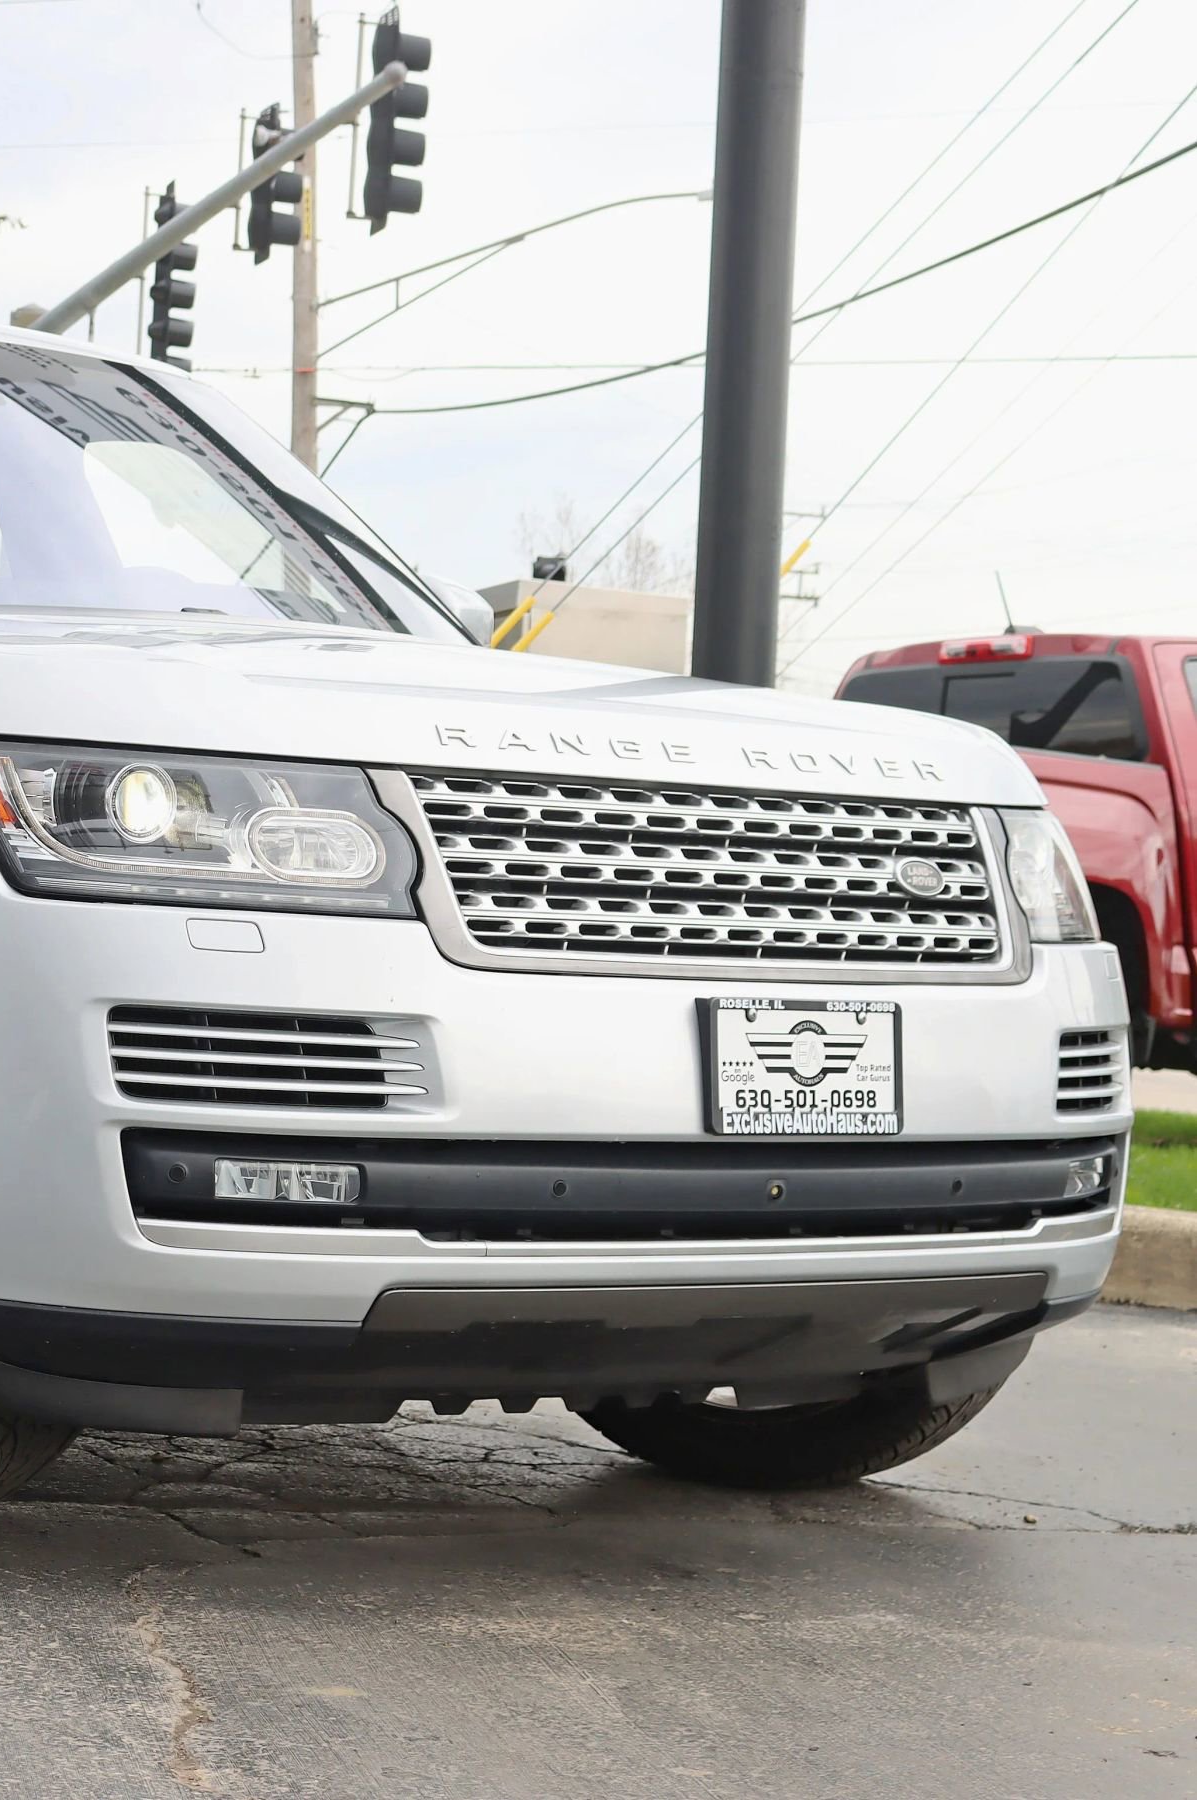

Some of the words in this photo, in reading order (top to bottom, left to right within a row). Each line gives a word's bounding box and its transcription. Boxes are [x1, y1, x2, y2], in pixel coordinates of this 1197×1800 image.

[435, 724, 697, 763] RANGE
[741, 746, 945, 782] ROVER
[719, 999, 772, 1010] ROSELLE,
[774, 999, 785, 1010] IL
[826, 1001, 896, 1013] 630-501-0698
[856, 1064, 869, 1073] Top
[870, 1064, 891, 1072] Rated
[721, 1070, 755, 1085] Google
[856, 1073, 868, 1081] Car
[870, 1074, 891, 1082] Gurus
[735, 1089, 877, 1109] 630-501-0698
[723, 1107, 898, 1135] ExclusiveAutoHaus.com
